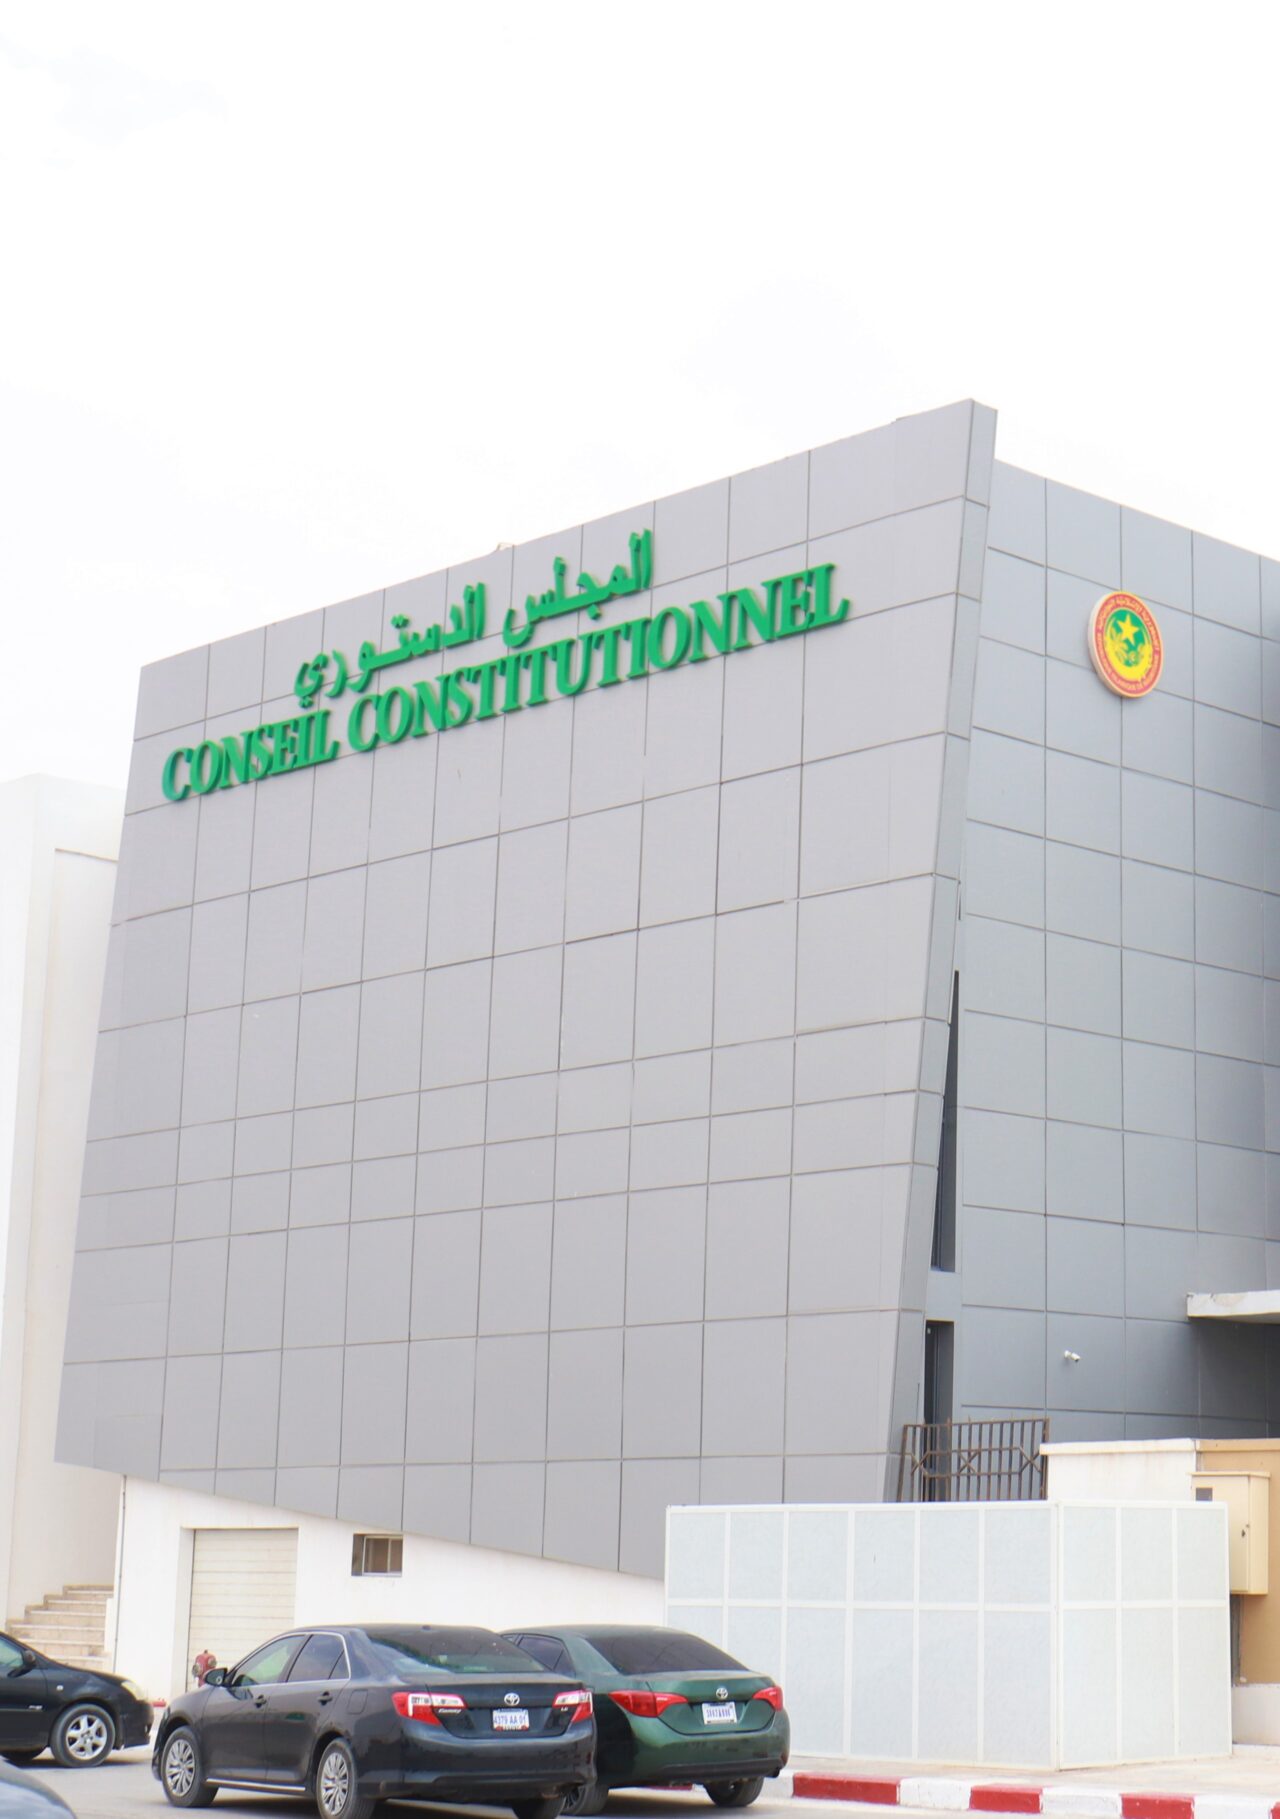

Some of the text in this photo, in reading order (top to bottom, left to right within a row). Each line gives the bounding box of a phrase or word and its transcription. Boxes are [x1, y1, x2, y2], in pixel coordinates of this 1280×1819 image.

[161, 562, 850, 802] CONSEIL CONSTITUTIONNEL
[294, 528, 655, 708] المجلس الدستوري
